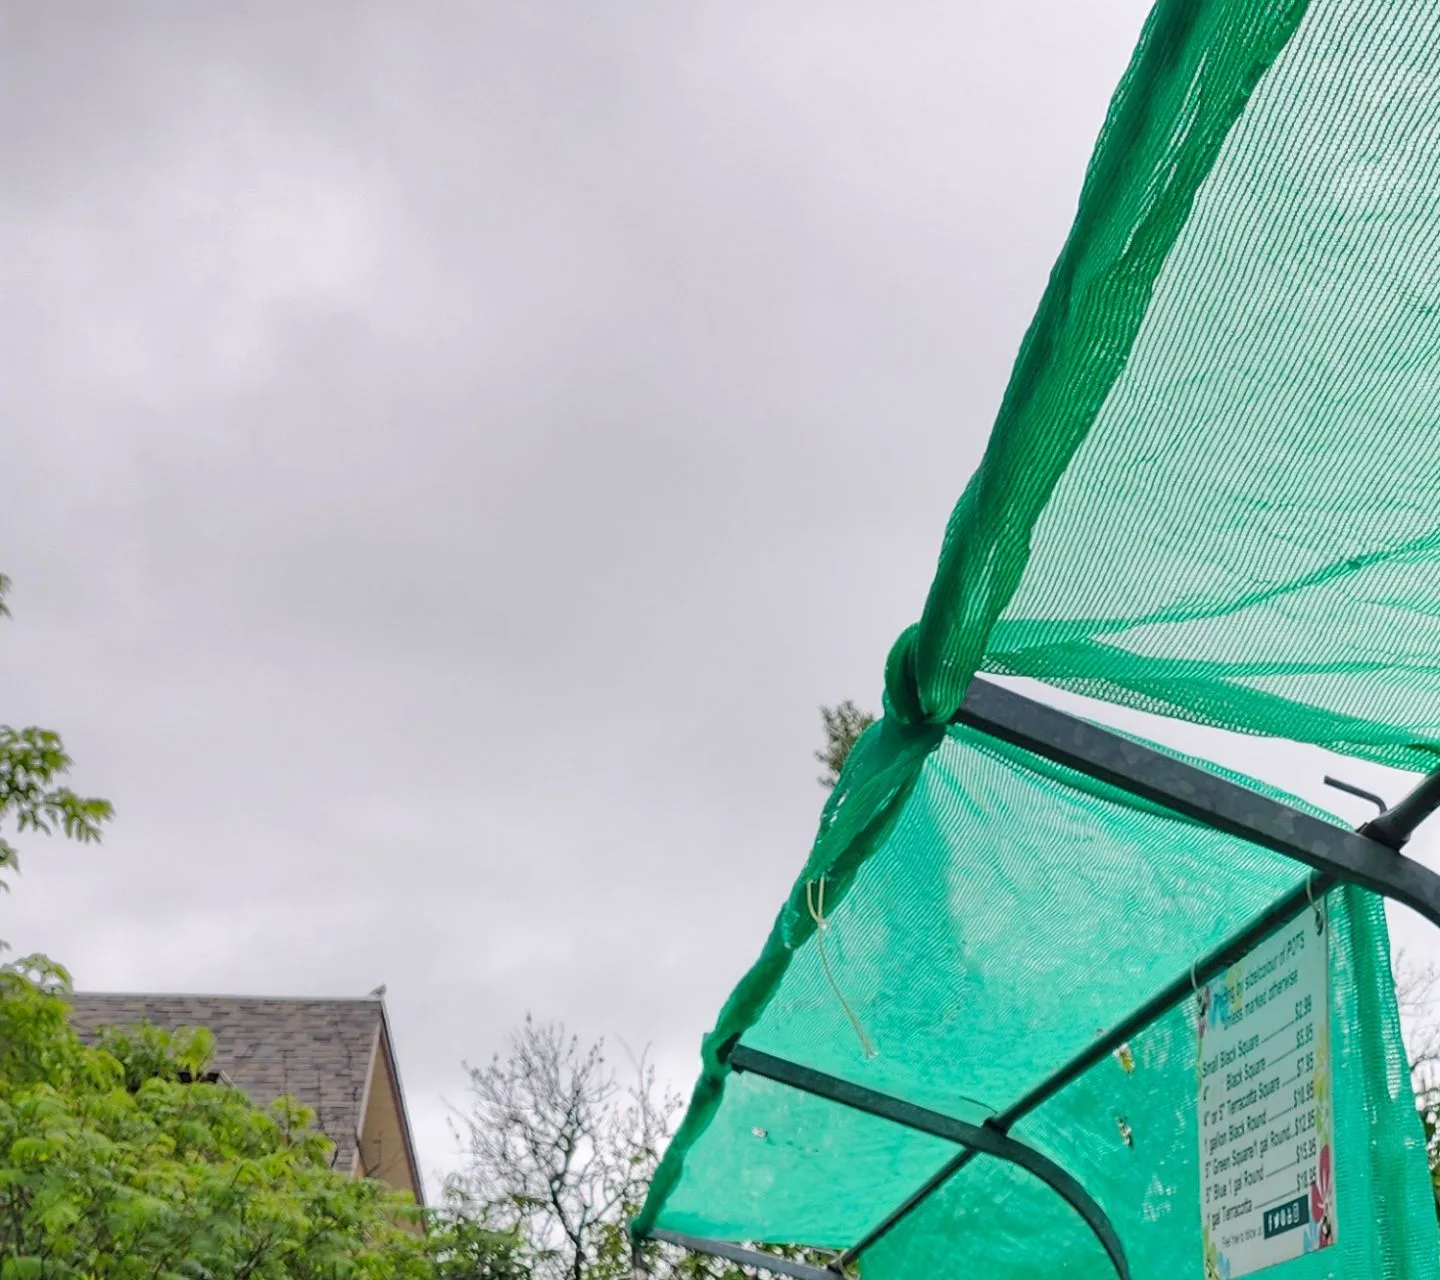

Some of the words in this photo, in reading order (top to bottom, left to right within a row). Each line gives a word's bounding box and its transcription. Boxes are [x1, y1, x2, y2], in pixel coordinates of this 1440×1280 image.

[1220, 1043, 1236, 1068] Black
[1238, 1034, 1259, 1058] Square
[1227, 1071, 1242, 1090] Black
[1245, 1058, 1265, 1081] Square
[1258, 1076, 1279, 1100] Square
[1229, 1120, 1244, 1142] Black
[1247, 1110, 1266, 1132] Round
[1213, 1180, 1226, 1200] Blue
[1244, 1165, 1263, 1187] Round
